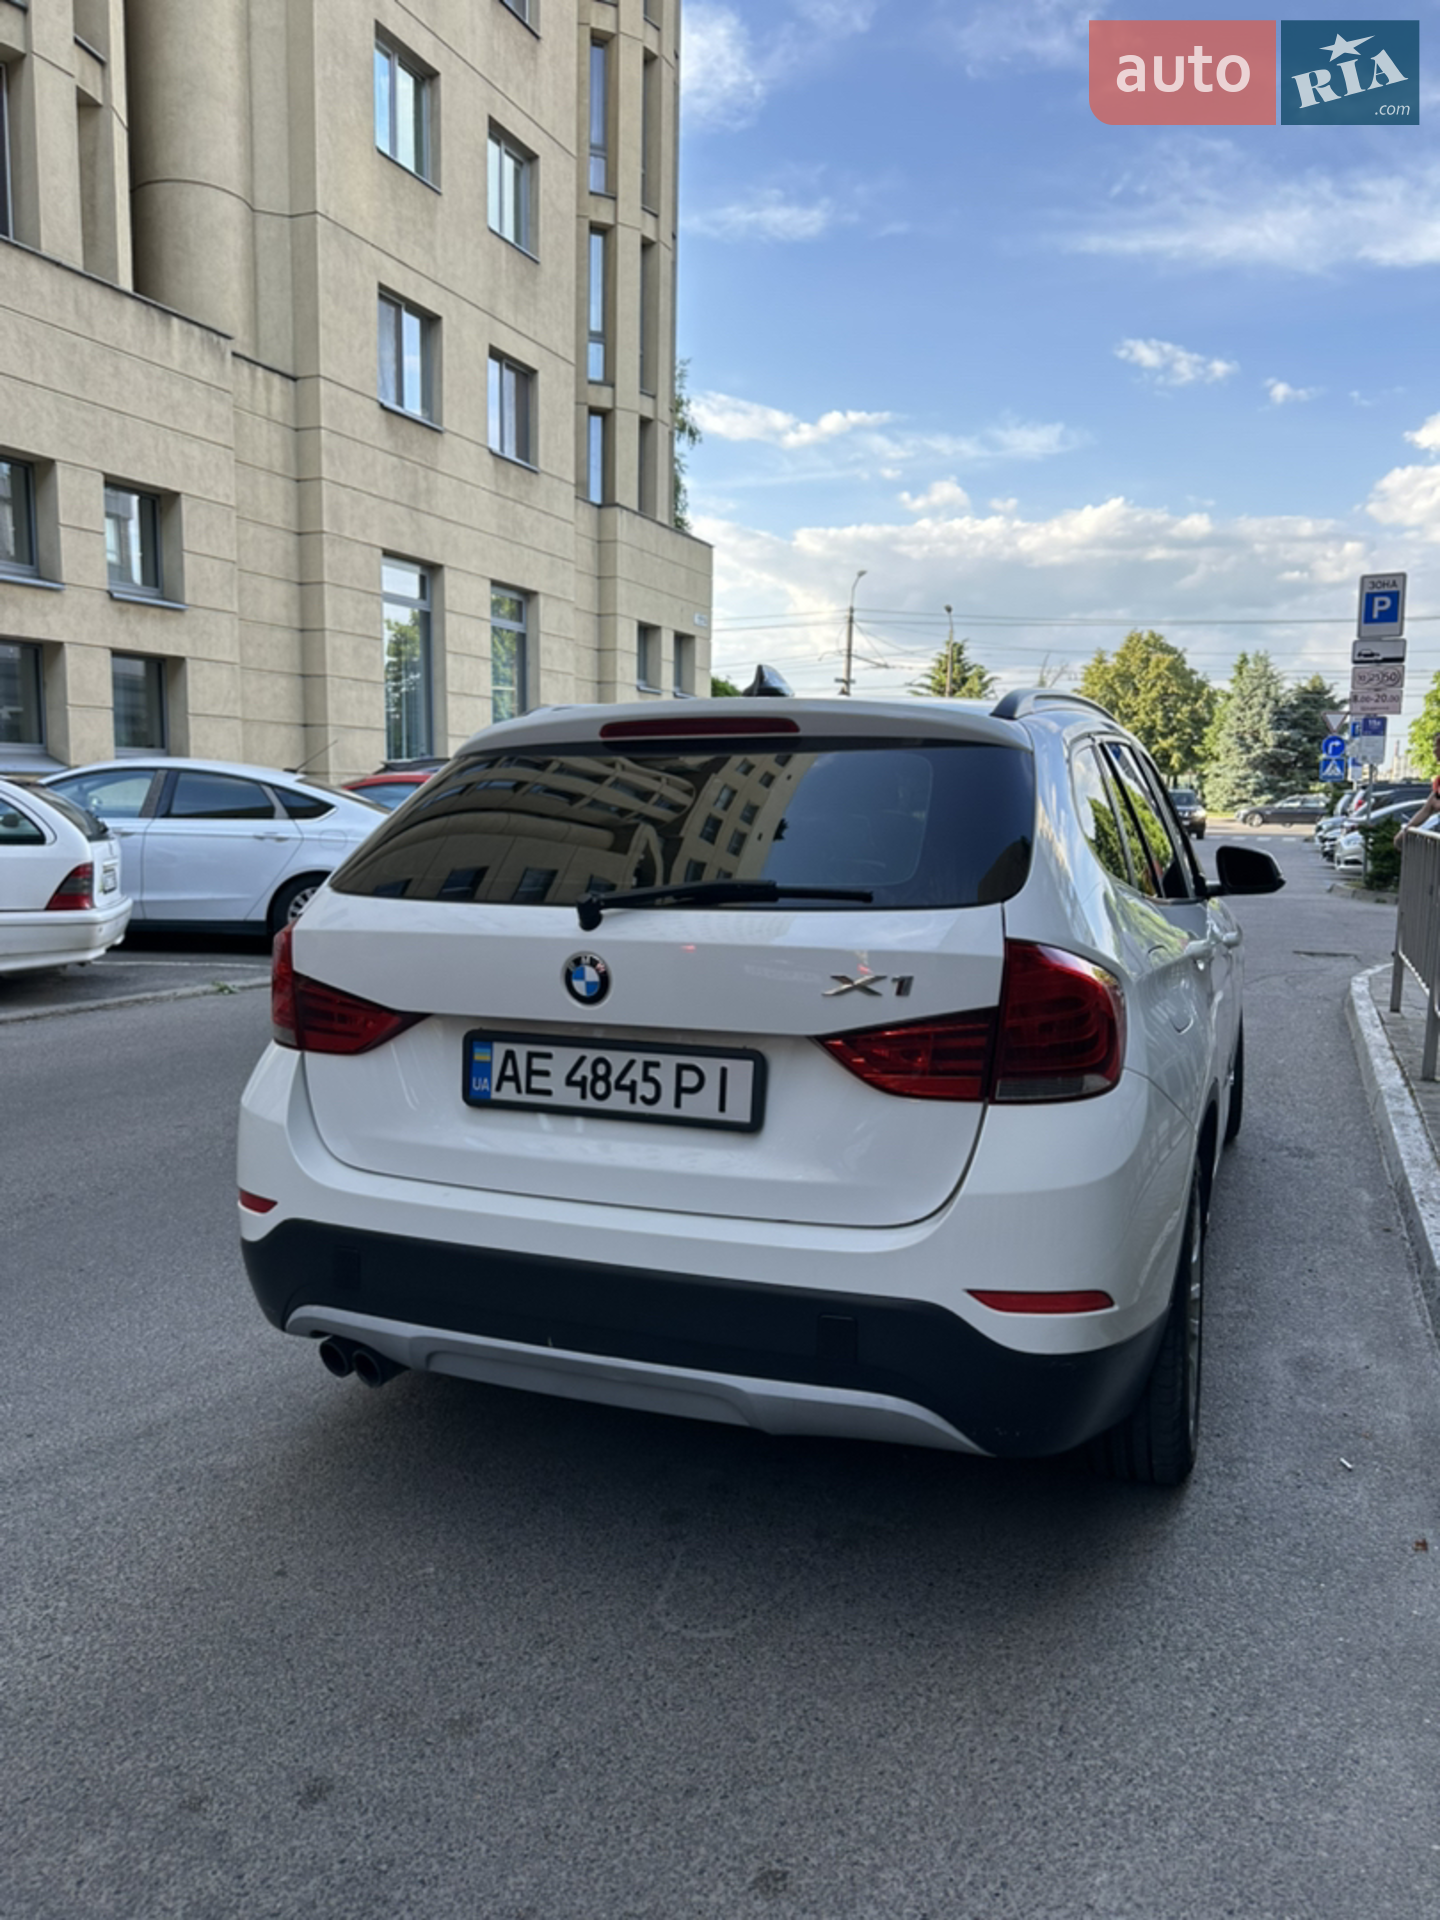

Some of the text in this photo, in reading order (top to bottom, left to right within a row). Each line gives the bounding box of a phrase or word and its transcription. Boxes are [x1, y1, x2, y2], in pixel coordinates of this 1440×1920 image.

[1369, 580, 1398, 590] ЗОНА
[1372, 596, 1392, 619] P
[821, 975, 914, 996] X1
[472, 1077, 490, 1092] UA
[494, 1049, 553, 1096] AE
[564, 1055, 663, 1106] 4845
